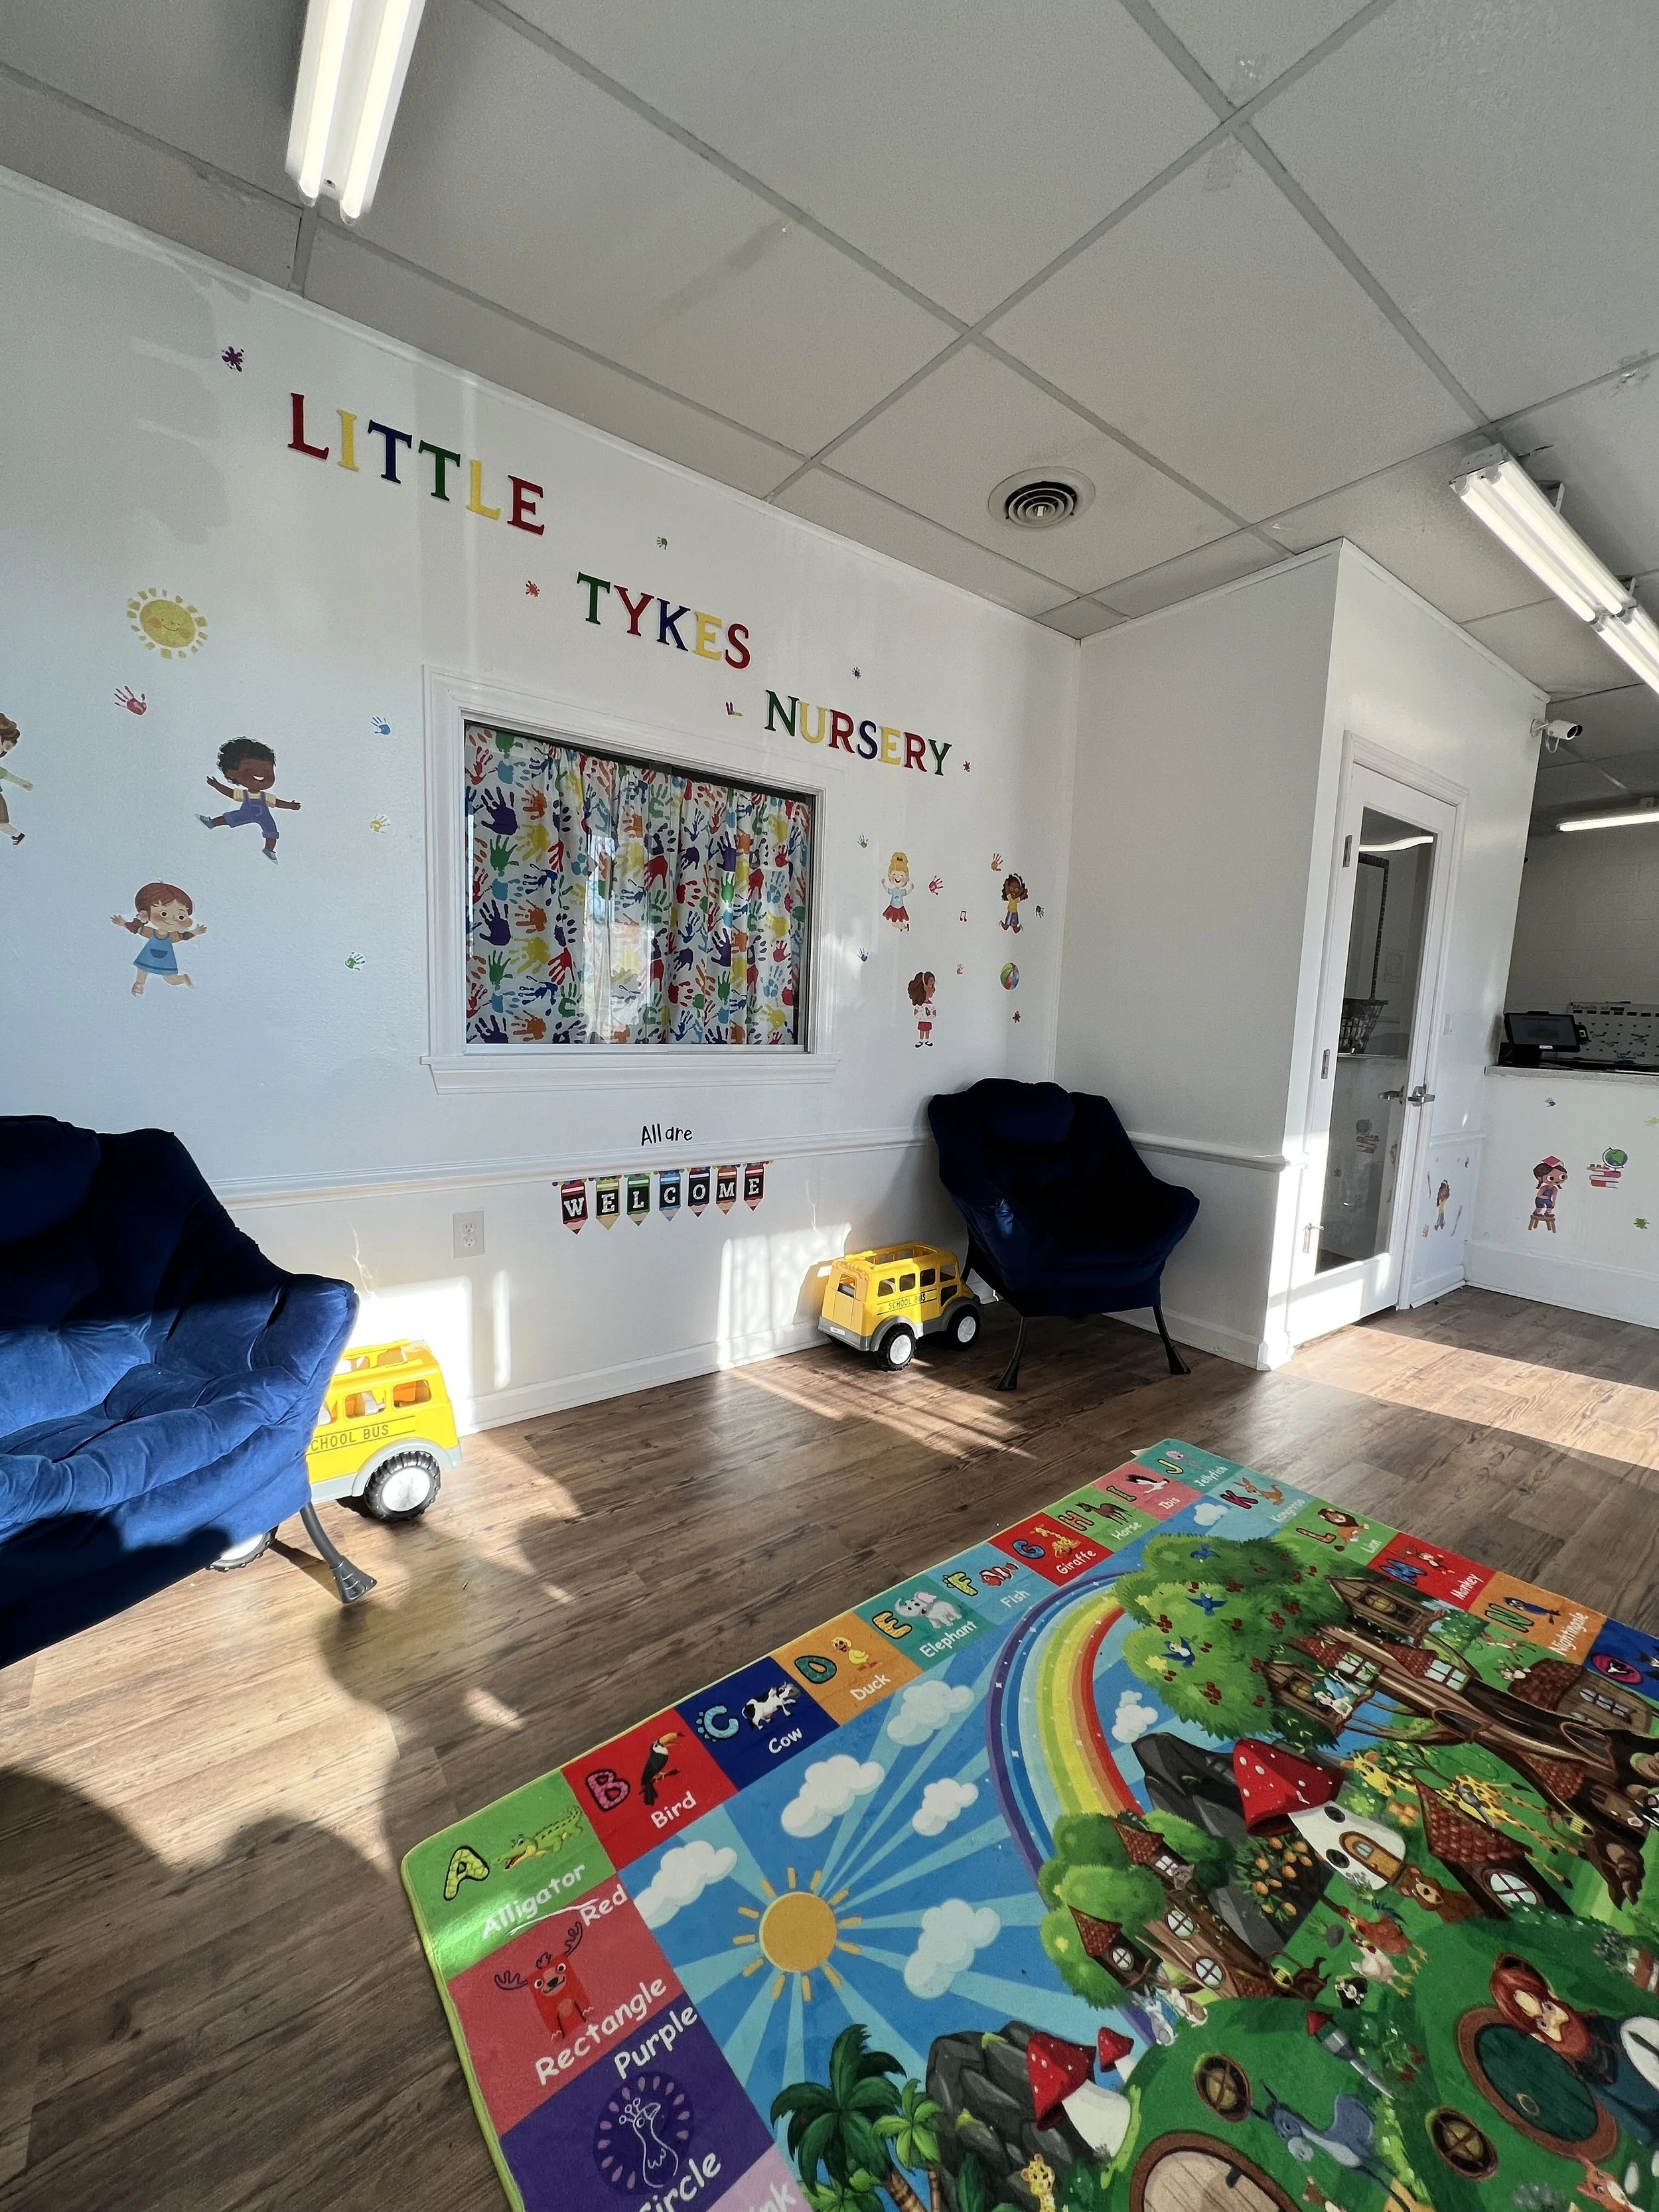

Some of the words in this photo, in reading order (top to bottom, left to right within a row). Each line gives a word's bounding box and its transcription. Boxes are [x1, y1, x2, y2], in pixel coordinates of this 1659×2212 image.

[287, 392, 545, 535] LITTLE
[576, 571, 751, 670] TYKES
[764, 690, 952, 776] NURSERY
[640, 1124, 662, 1146] All
[665, 1126, 693, 1141] are
[563, 1178, 760, 1217] WELCOME
[889, 1298, 912, 1310] SCHOOL
[914, 1293, 926, 1303] BUS
[311, 1432, 356, 1451] CHOOL
[363, 1424, 389, 1440] BUS
[1157, 1458, 1184, 1475] J
[1194, 1466, 1229, 1487] Jellyfish
[1158, 1495, 1181, 1511] Ibis
[1220, 1489, 1259, 1510] K
[1269, 1499, 1305, 1524] Kangaroo
[1057, 1510, 1095, 1532] H
[1112, 1520, 1142, 1541] Horse
[1012, 1539, 1045, 1560] G
[1295, 1527, 1336, 1544] L
[1360, 1539, 1382, 1554] Lion
[1056, 1548, 1098, 1576] Giraffe
[1379, 1558, 1427, 1586] M
[942, 1571, 978, 1597] F
[1450, 1573, 1484, 1600] Monkey
[1000, 1589, 1031, 1609] Fish
[872, 1610, 914, 1640] E
[1484, 1602, 1535, 1633] N
[918, 1619, 977, 1658] Elephant
[1548, 1612, 1589, 1657] Nightingale
[794, 1654, 837, 1685] D
[849, 1673, 892, 1701] Duck
[697, 1704, 741, 1743] C
[767, 1727, 804, 1755] Cow
[585, 1768, 631, 1812] B
[650, 1791, 697, 1830] Bird
[443, 1845, 490, 1901] A
[482, 1863, 587, 1941] Alligator
[580, 1883, 629, 1927] Red
[535, 1978, 668, 2086] Rectangle
[614, 2005, 699, 2080] Purple
